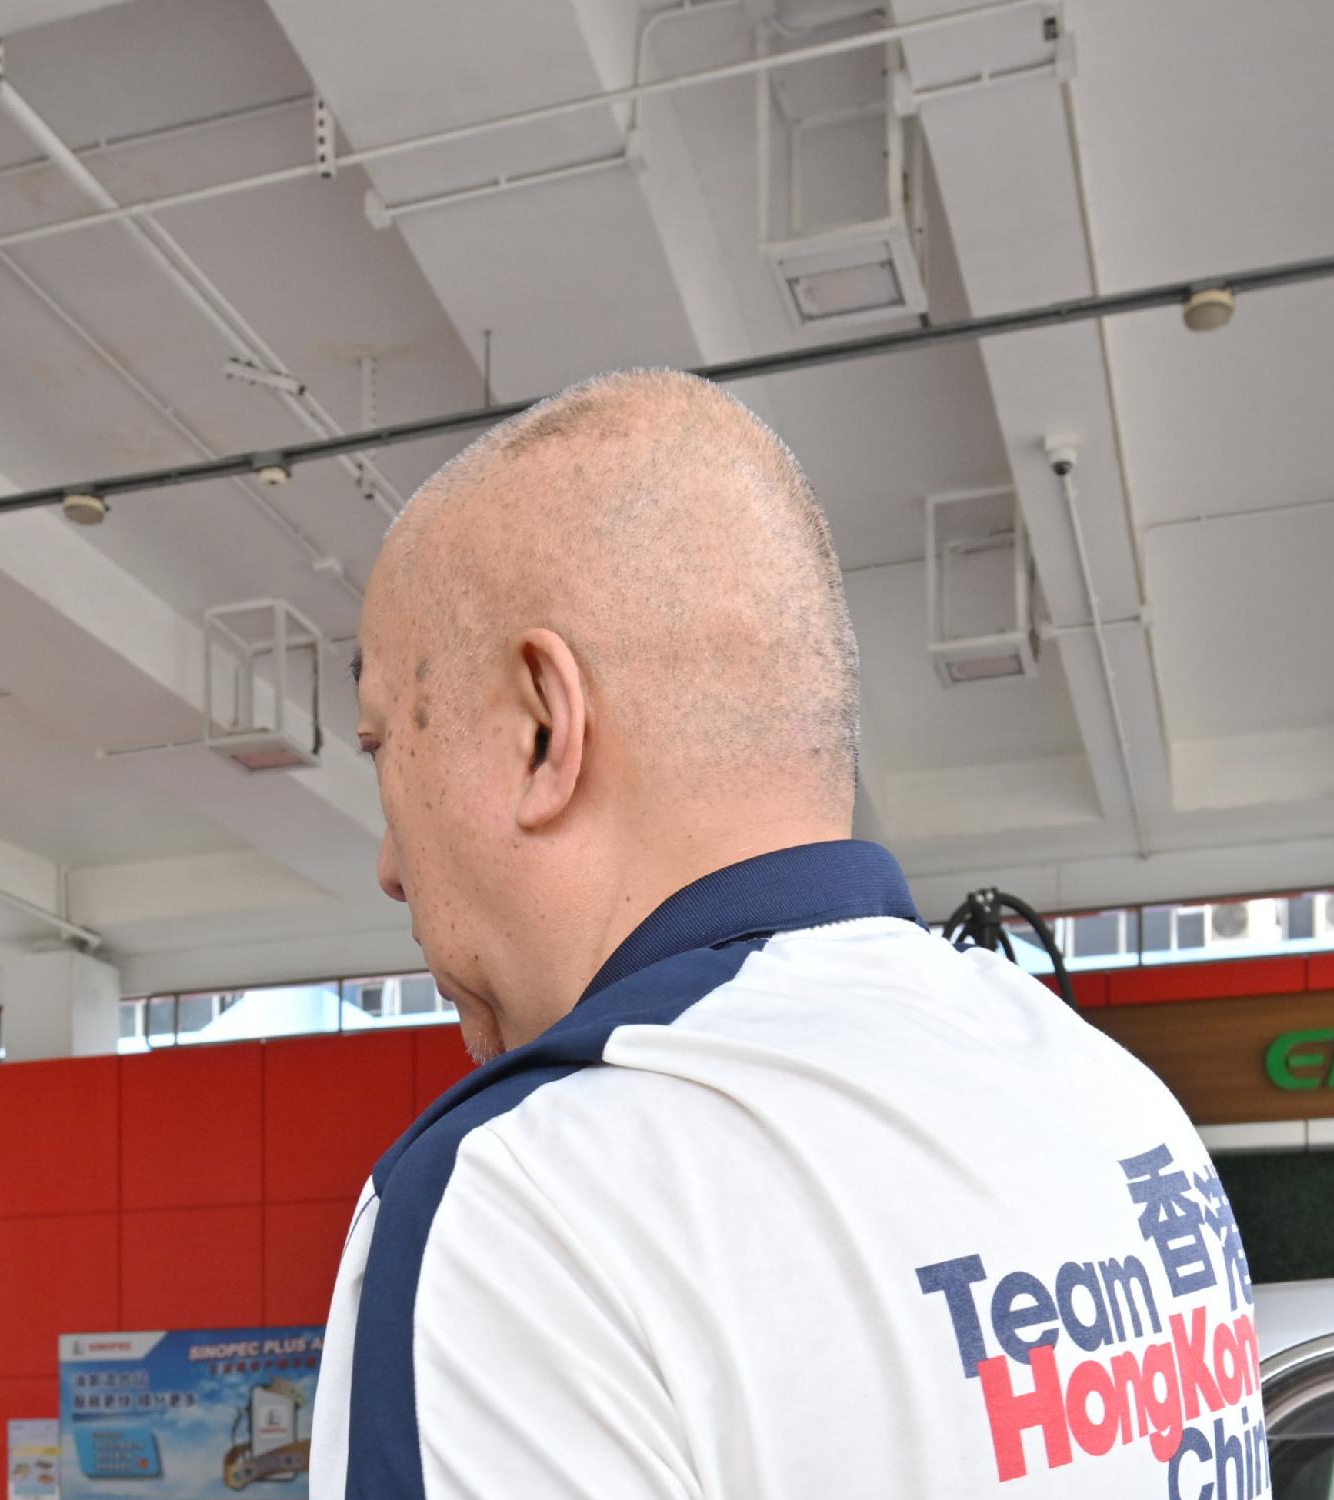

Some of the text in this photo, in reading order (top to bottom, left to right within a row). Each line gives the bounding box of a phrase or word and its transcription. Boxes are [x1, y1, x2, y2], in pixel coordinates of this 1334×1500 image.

[263, 1337, 306, 1354] PLUS
[915, 1253, 1163, 1379] Team
[977, 1305, 1260, 1483] HongKon
